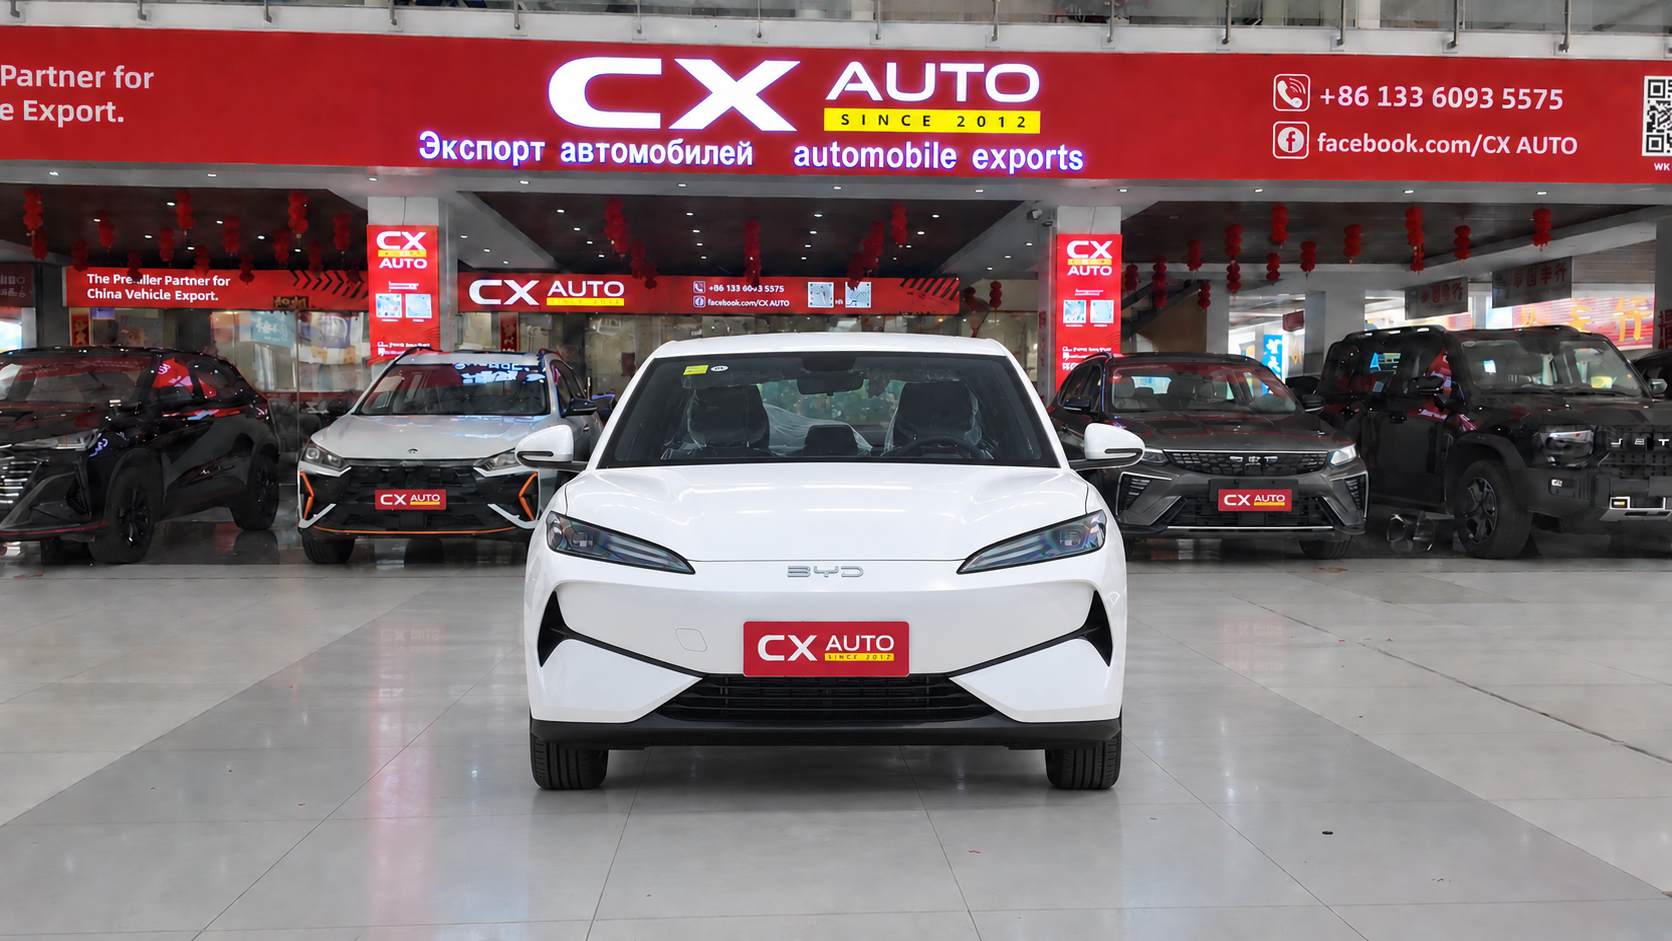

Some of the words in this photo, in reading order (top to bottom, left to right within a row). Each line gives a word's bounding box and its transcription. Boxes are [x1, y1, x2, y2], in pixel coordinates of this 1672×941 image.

[0, 64, 106, 88] Partner
[113, 65, 154, 89] for
[548, 57, 801, 132] CX
[825, 61, 1041, 103] AUTO
[1320, 85, 1369, 107] +86
[1377, 86, 1424, 107] 133
[1431, 87, 1494, 109] 6093
[1501, 89, 1564, 110] 5575
[23, 100, 125, 128] Export.
[841, 113, 931, 127] SINCE
[956, 115, 1026, 128] 2012
[418, 130, 546, 168] Экспорт
[559, 138, 754, 166] автомобилей
[1317, 132, 1510, 158] facebook.com/CX
[1516, 136, 1578, 155] AUTO
[793, 141, 957, 170] automobile
[971, 144, 1084, 175] exports
[376, 231, 426, 250] CX
[1066, 240, 1113, 260] CX
[379, 258, 428, 269] AUTO
[1067, 265, 1112, 276] AUTO
[87, 273, 110, 284] The
[164, 275, 209, 286] Partner
[212, 275, 230, 286] for
[709, 284, 724, 292] +86
[726, 284, 740, 292] 133
[764, 285, 785, 293] 5575
[87, 288, 122, 299] China
[125, 289, 171, 300] Vehicle
[175, 290, 219, 303] Export.
[469, 279, 540, 306] CX
[547, 280, 625, 297] AUTO
[380, 494, 407, 505] CX
[1224, 494, 1251, 506] CX
[1254, 494, 1286, 502] AUTO
[787, 565, 864, 578] BYD
[757, 634, 818, 662] CX
[825, 635, 895, 652] AUTO
